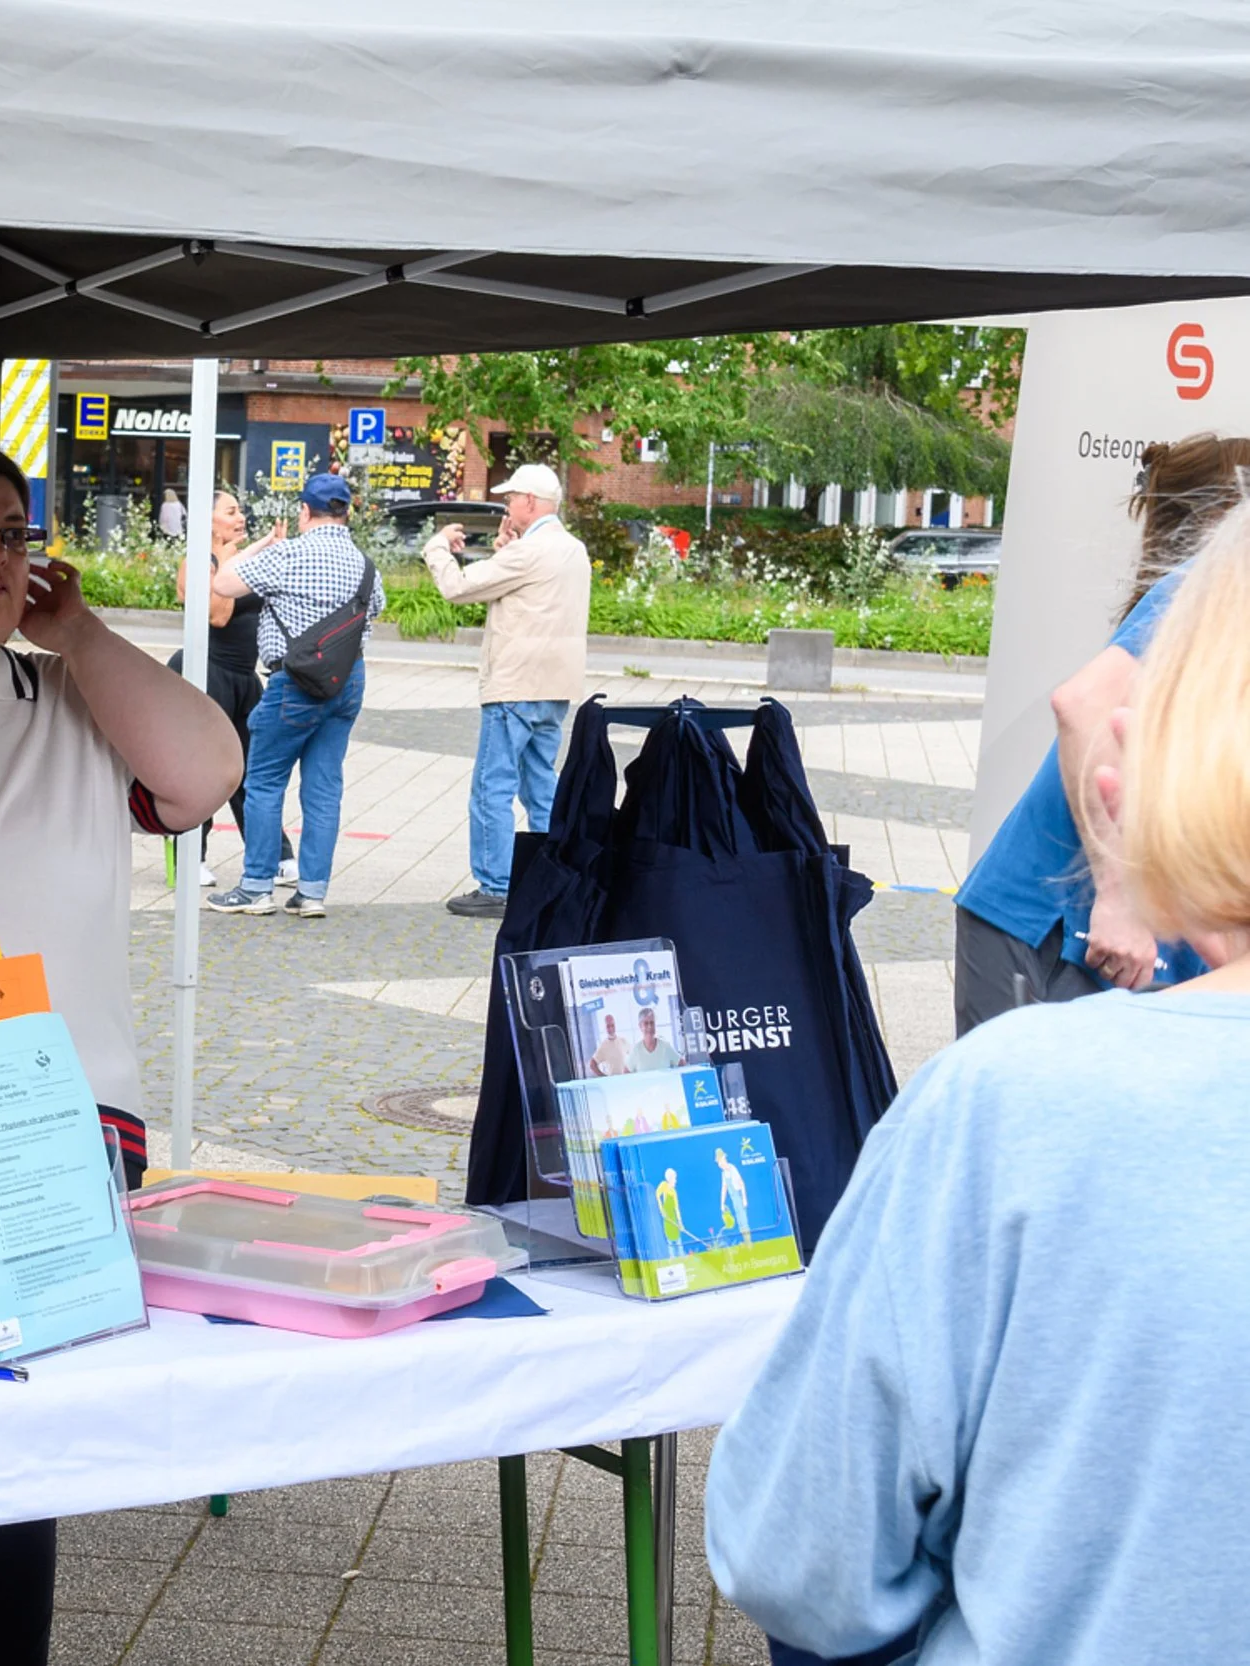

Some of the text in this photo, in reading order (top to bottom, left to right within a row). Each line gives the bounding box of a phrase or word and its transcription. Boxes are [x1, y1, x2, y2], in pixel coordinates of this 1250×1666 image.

[356, 413, 378, 441] P
[578, 974, 639, 989] Gleichgewicht
[645, 969, 671, 981] Kraft
[690, 1005, 791, 1031] BURGER
